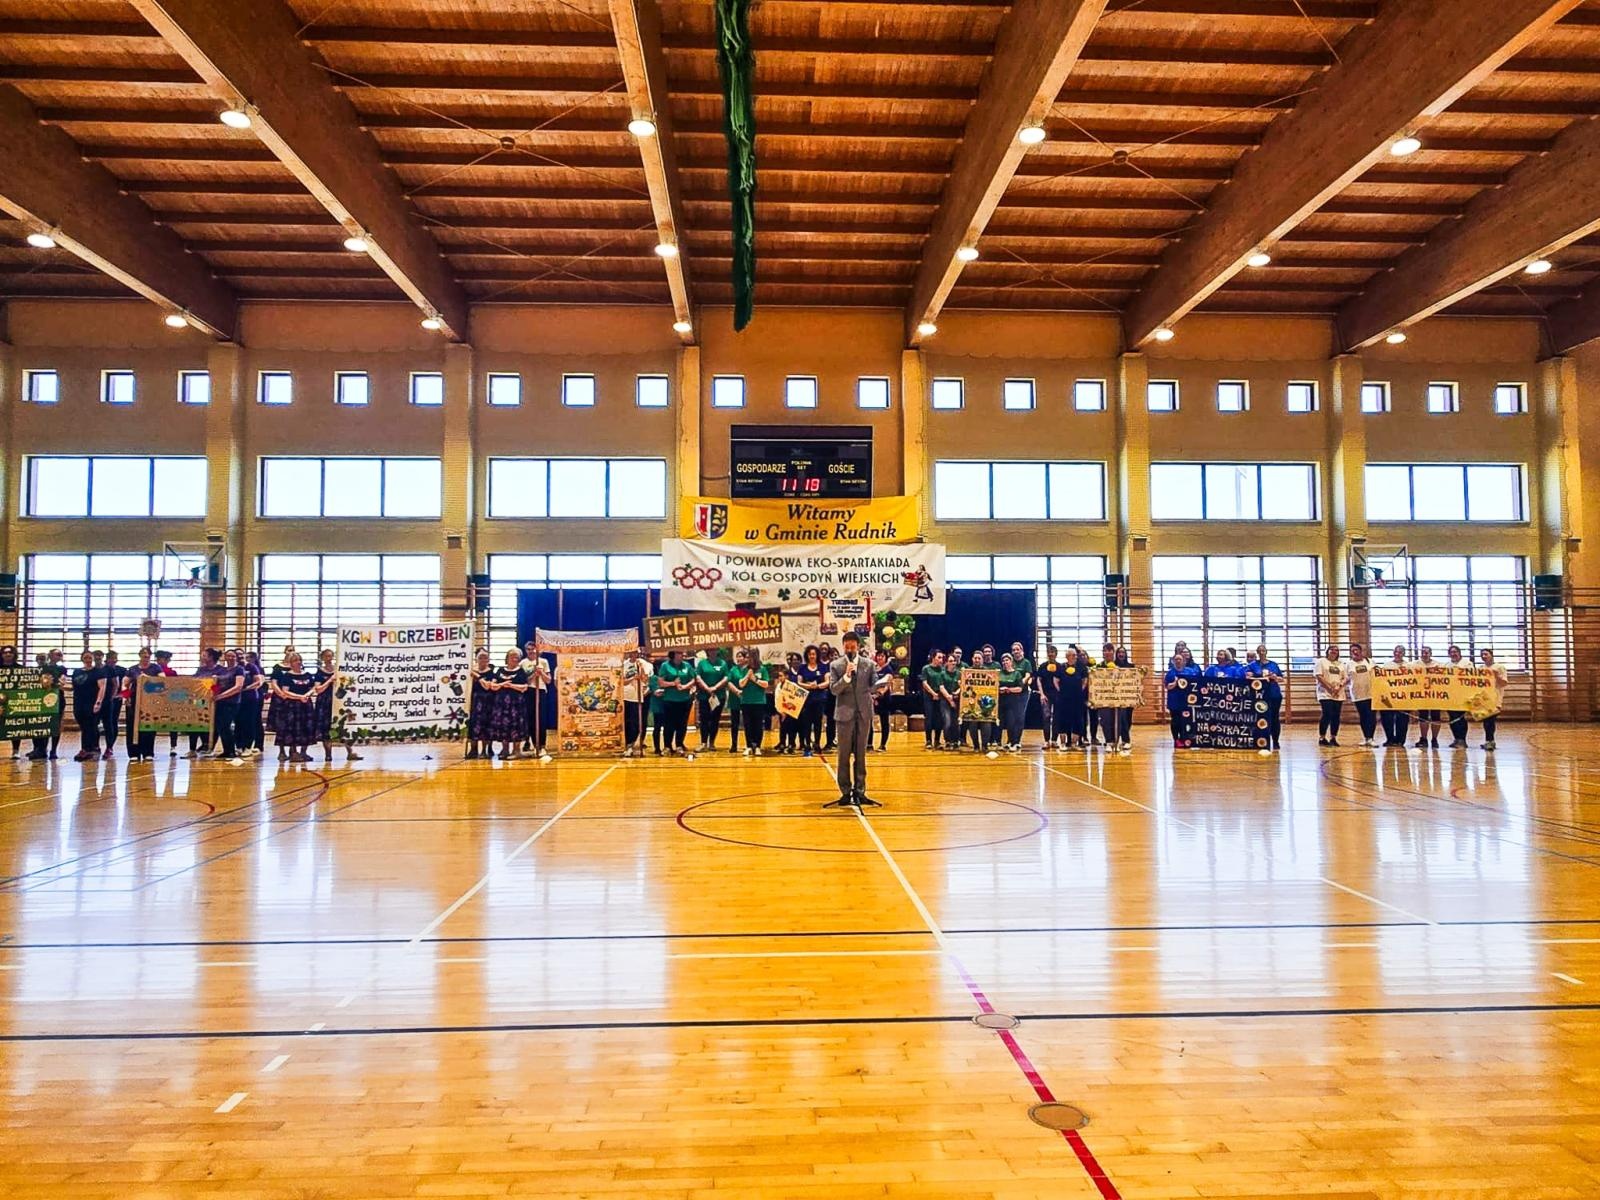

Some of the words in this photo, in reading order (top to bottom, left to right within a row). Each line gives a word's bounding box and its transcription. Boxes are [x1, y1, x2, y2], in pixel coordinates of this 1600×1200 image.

[736, 463, 787, 474] GOSPODARZE
[828, 461, 855, 474] GOŚCIE
[787, 503, 856, 523] Witamy
[744, 529, 760, 540] w
[765, 522, 828, 541] Gminie
[833, 521, 897, 540] Rudnik
[716, 555, 720, 565] I
[725, 555, 801, 568] POWIATOWA
[807, 557, 910, 568] EKO-SPARTAKIADA
[731, 570, 756, 582] KÓŁ
[761, 571, 833, 583] GOSPODYŃ
[838, 572, 900, 584] WIEJSKICH
[799, 587, 838, 599] 2026
[649, 617, 688, 638] EKO
[692, 621, 705, 632] TO
[708, 620, 725, 631] NIE
[728, 612, 781, 632] moda
[341, 629, 372, 644] KGW
[378, 624, 470, 644] POGRZEBIEŃ
[650, 638, 661, 649] TO
[664, 637, 690, 648] NASZE
[693, 633, 734, 645] ZDROWIE
[736, 632, 740, 641] I
[744, 628, 780, 641] URODA!
[344, 651, 365, 662] KGW
[367, 653, 416, 666] Pogrzebień
[448, 649, 467, 659] trwa
[338, 662, 376, 673] młodość
[384, 662, 453, 673] doświadczeniem
[454, 663, 469, 674] gra
[1374, 667, 1413, 677] BUTELKA
[1415, 667, 1422, 675] W
[1426, 667, 1454, 676] KOSZU
[1457, 667, 1493, 677] ZNIKA
[357, 674, 385, 684] Gmina
[1387, 677, 1418, 687] WRACA
[1424, 677, 1450, 689] JAKO
[1458, 677, 1491, 688] TORBA
[391, 685, 409, 696] jest
[411, 683, 423, 693] od
[426, 683, 440, 693] lat
[1191, 682, 1198, 692] Z
[1390, 691, 1407, 700] DLA
[1410, 690, 1449, 700] ROLNIKA
[389, 695, 430, 710] przyrodę
[432, 695, 443, 705] to
[1202, 696, 1253, 712] ZGODZIE
[362, 709, 398, 721] wspólny
[404, 707, 427, 718] świat
[1197, 722, 1210, 733] NA
[1194, 733, 1254, 748] RZYRODZIE
